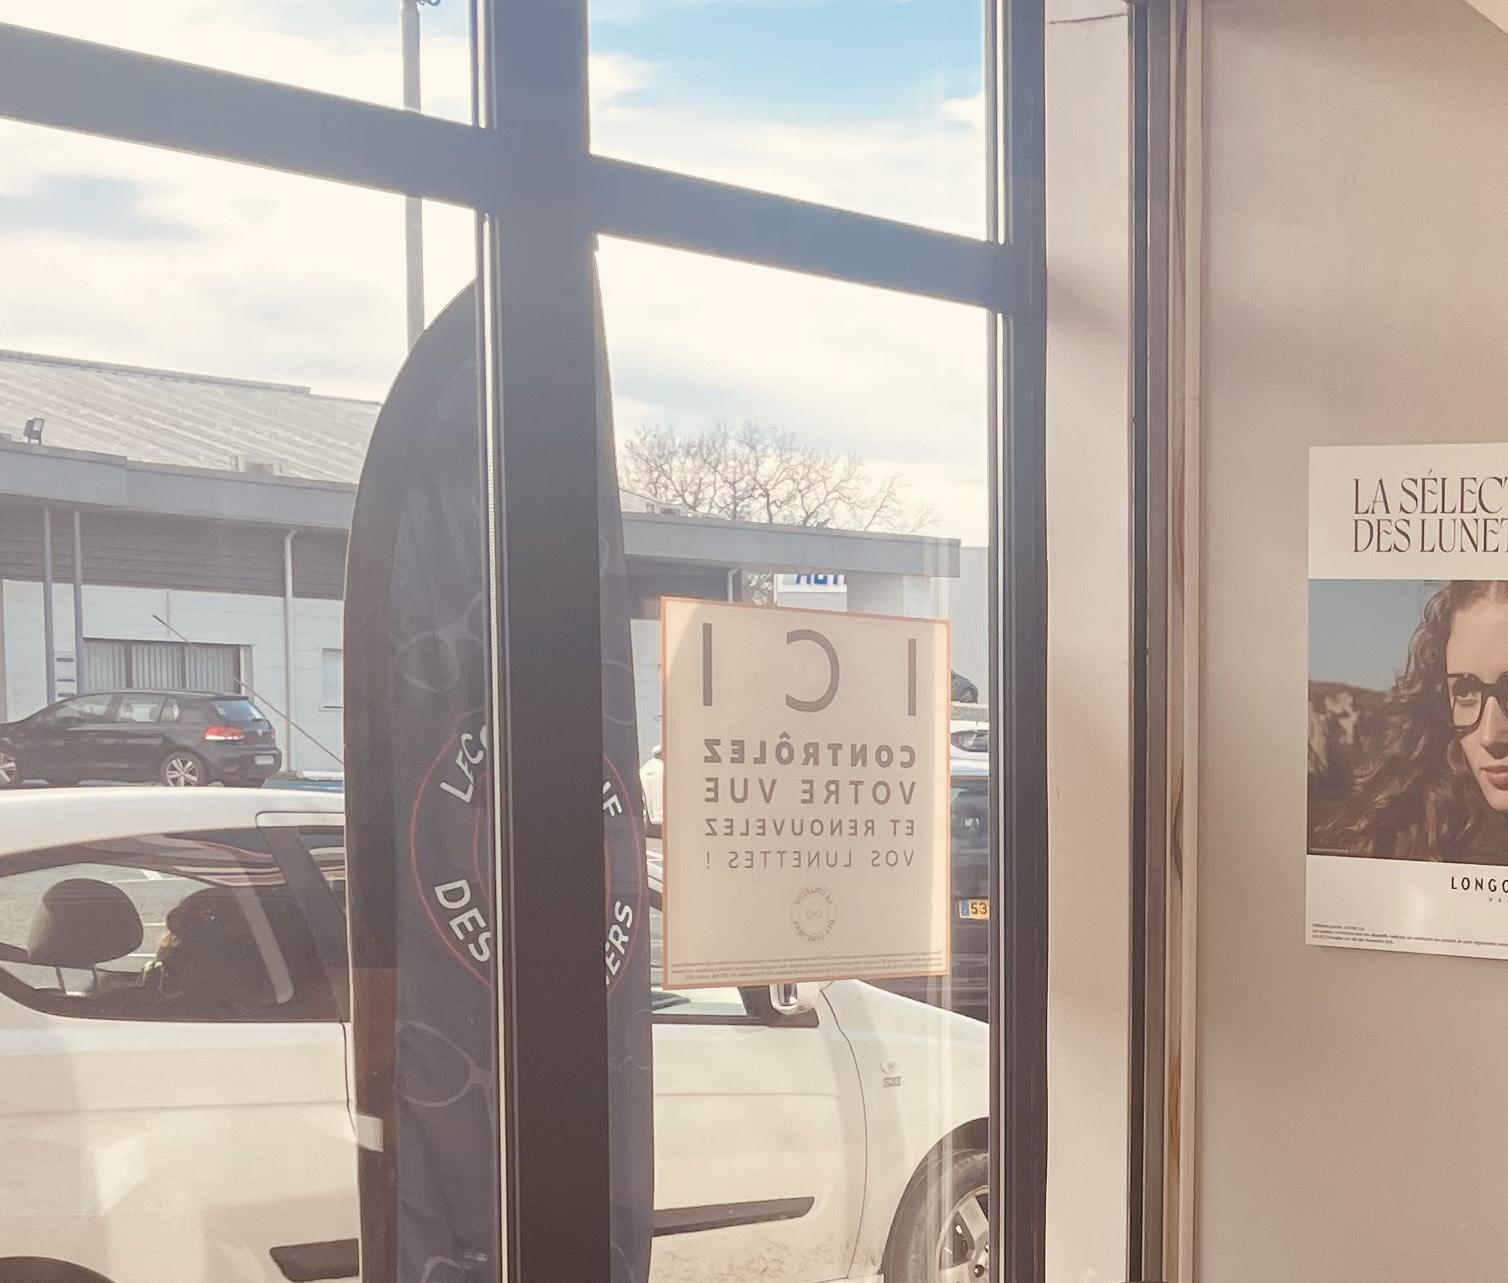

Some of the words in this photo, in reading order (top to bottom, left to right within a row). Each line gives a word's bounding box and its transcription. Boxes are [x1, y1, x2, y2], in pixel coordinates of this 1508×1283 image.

[1353, 477, 1391, 515] LA
[1353, 517, 1411, 553] DES
[440, 749, 475, 803] LE
[435, 879, 491, 962] DES
